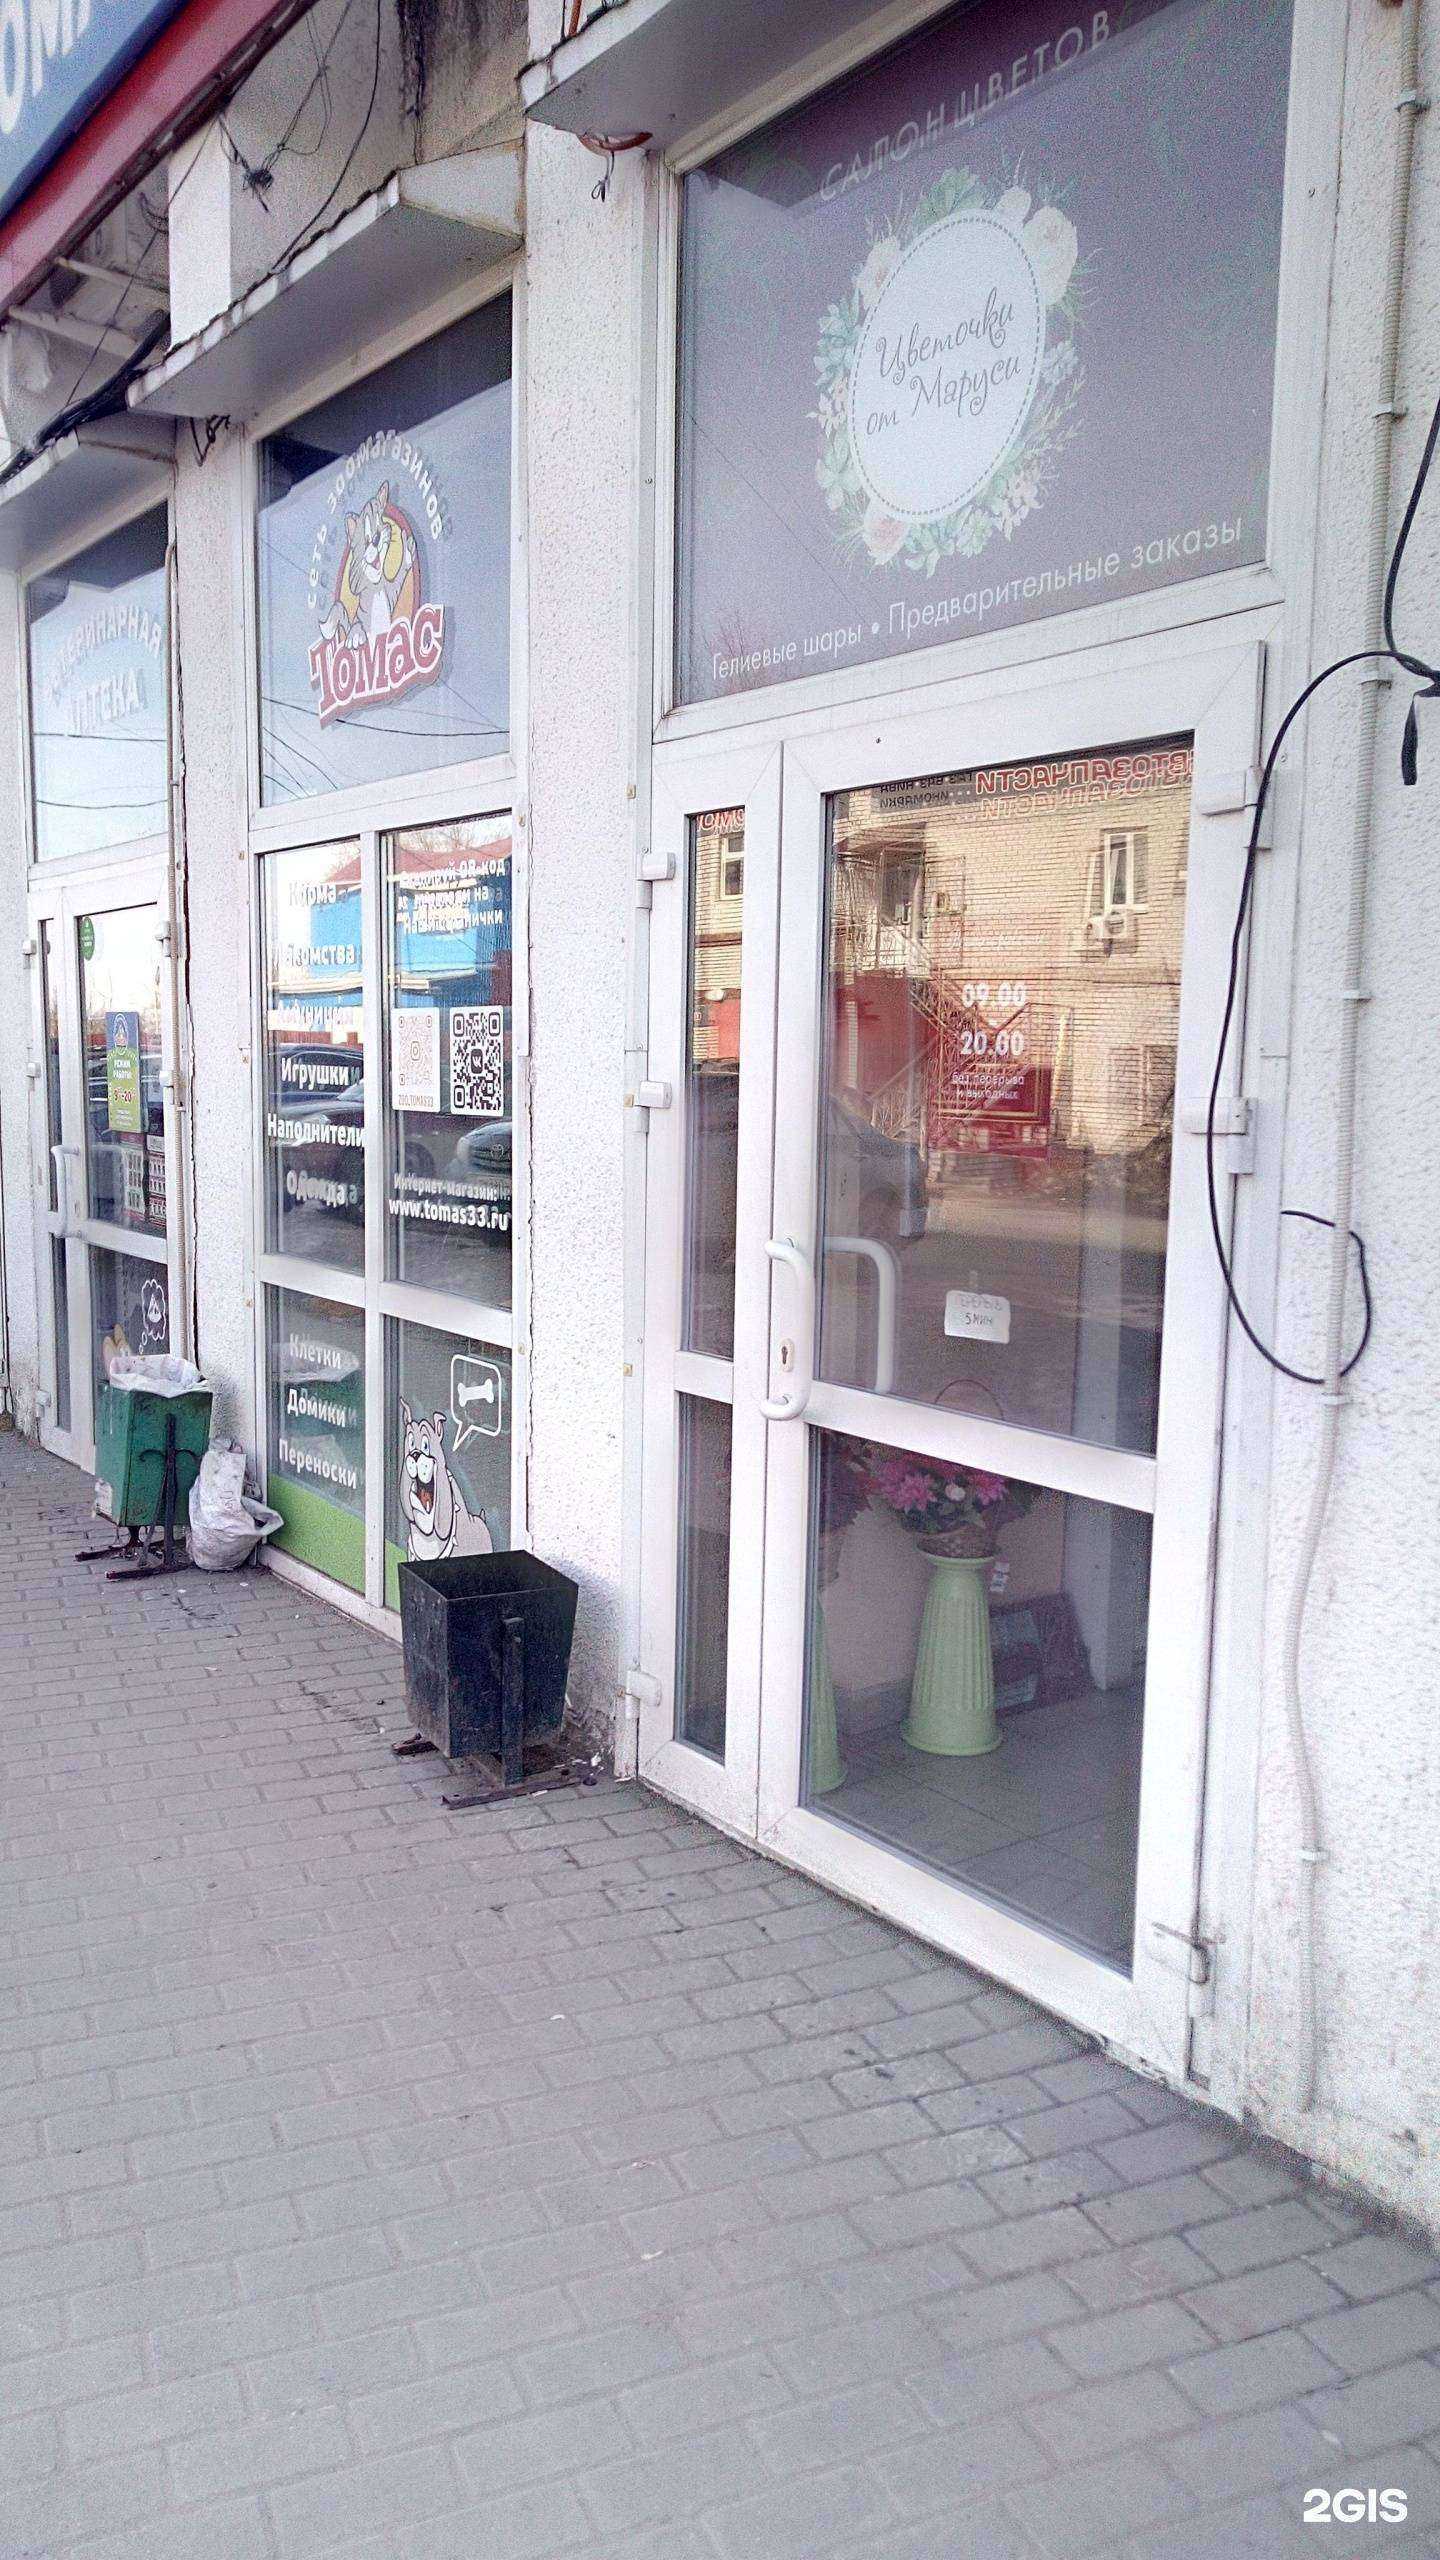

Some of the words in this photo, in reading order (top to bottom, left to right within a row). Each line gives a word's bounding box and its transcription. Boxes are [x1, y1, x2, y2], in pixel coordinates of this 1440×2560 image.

[820, 103, 946, 201] САЛОН
[953, 10, 1110, 128] ЦВЕТОВ
[876, 286, 1015, 386] Цветочки
[866, 410, 899, 436] от
[910, 356, 1022, 418] Маруси
[713, 637, 797, 681] Гелиевые
[803, 622, 863, 661] шары
[887, 551, 1121, 638] Предварительные
[1131, 515, 1243, 569] заказы
[289, 883, 337, 906] Корма
[962, 981, 1026, 1008] 09.00
[960, 1030, 1025, 1056] 20.00
[281, 1057, 349, 1090] Игрушки
[267, 1113, 365, 1148] Наполнители
[388, 1199, 509, 1232] www.tomas33.ru
[289, 1333, 342, 1369] Клетки
[287, 1388, 347, 1428] Домики
[279, 1437, 357, 1490] Переноски
